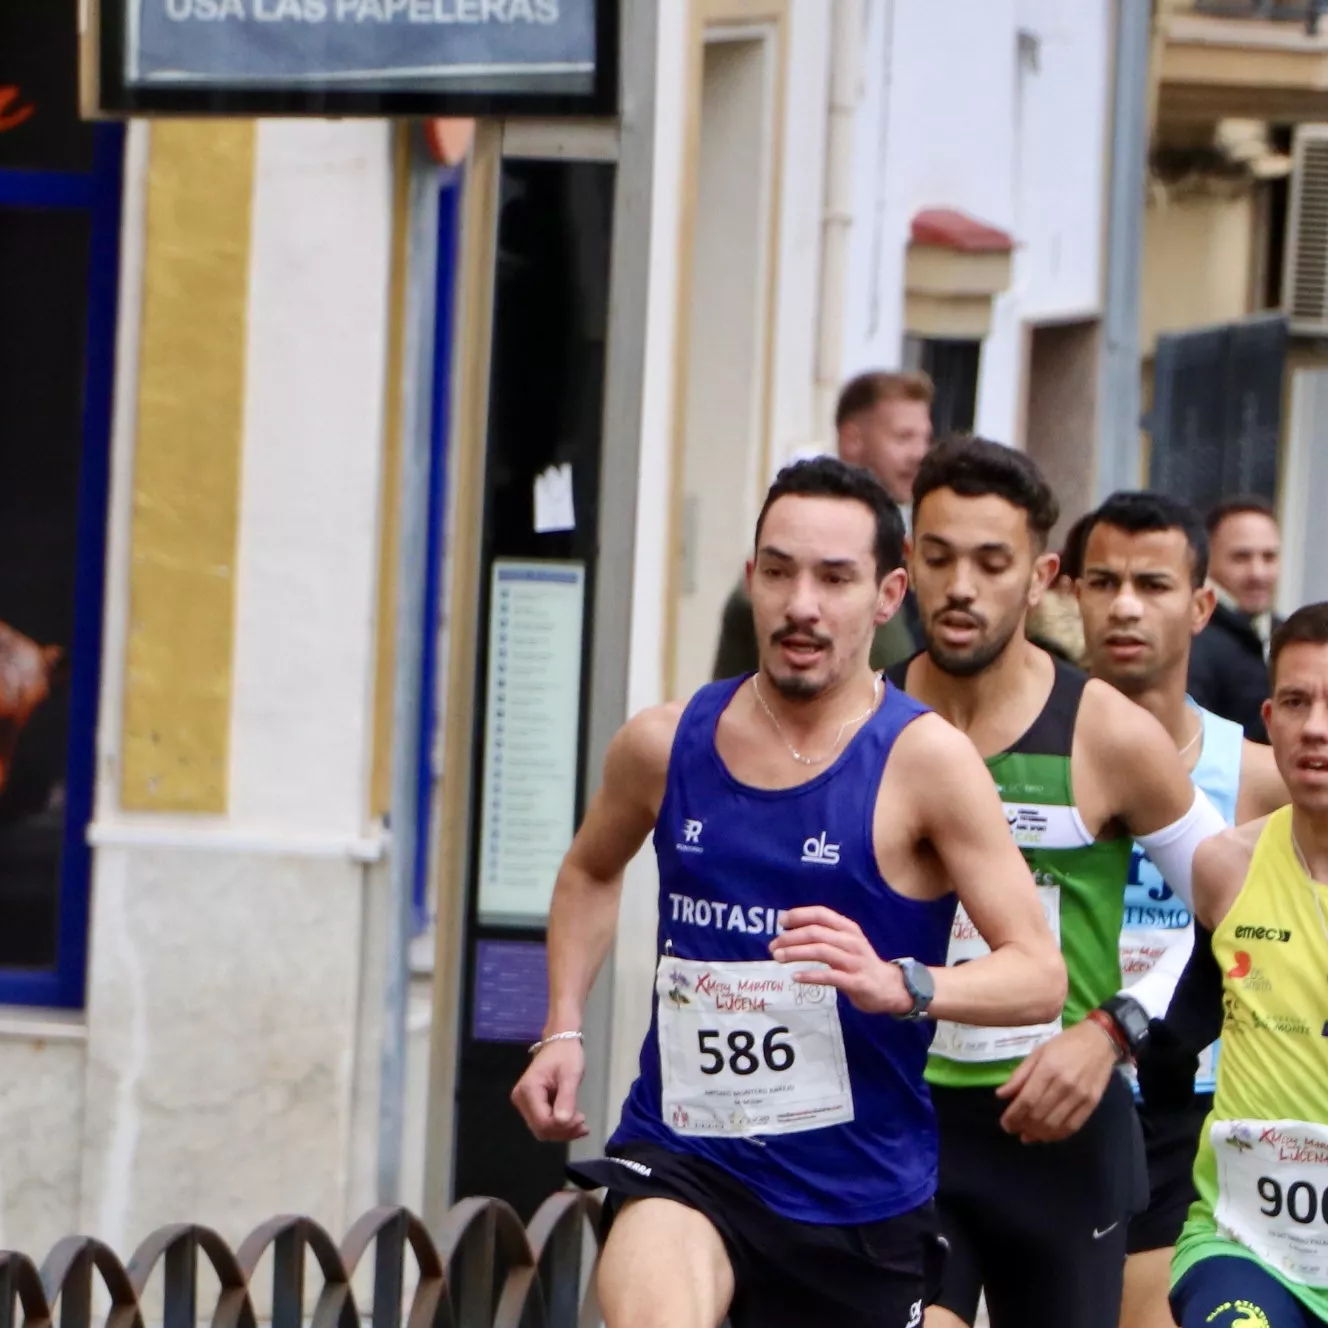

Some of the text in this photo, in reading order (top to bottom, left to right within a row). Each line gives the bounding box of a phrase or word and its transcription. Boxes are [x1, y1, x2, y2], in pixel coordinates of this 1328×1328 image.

[165, 0, 559, 24] USA LAS PAPELERAS
[697, 1026, 795, 1076] 586
